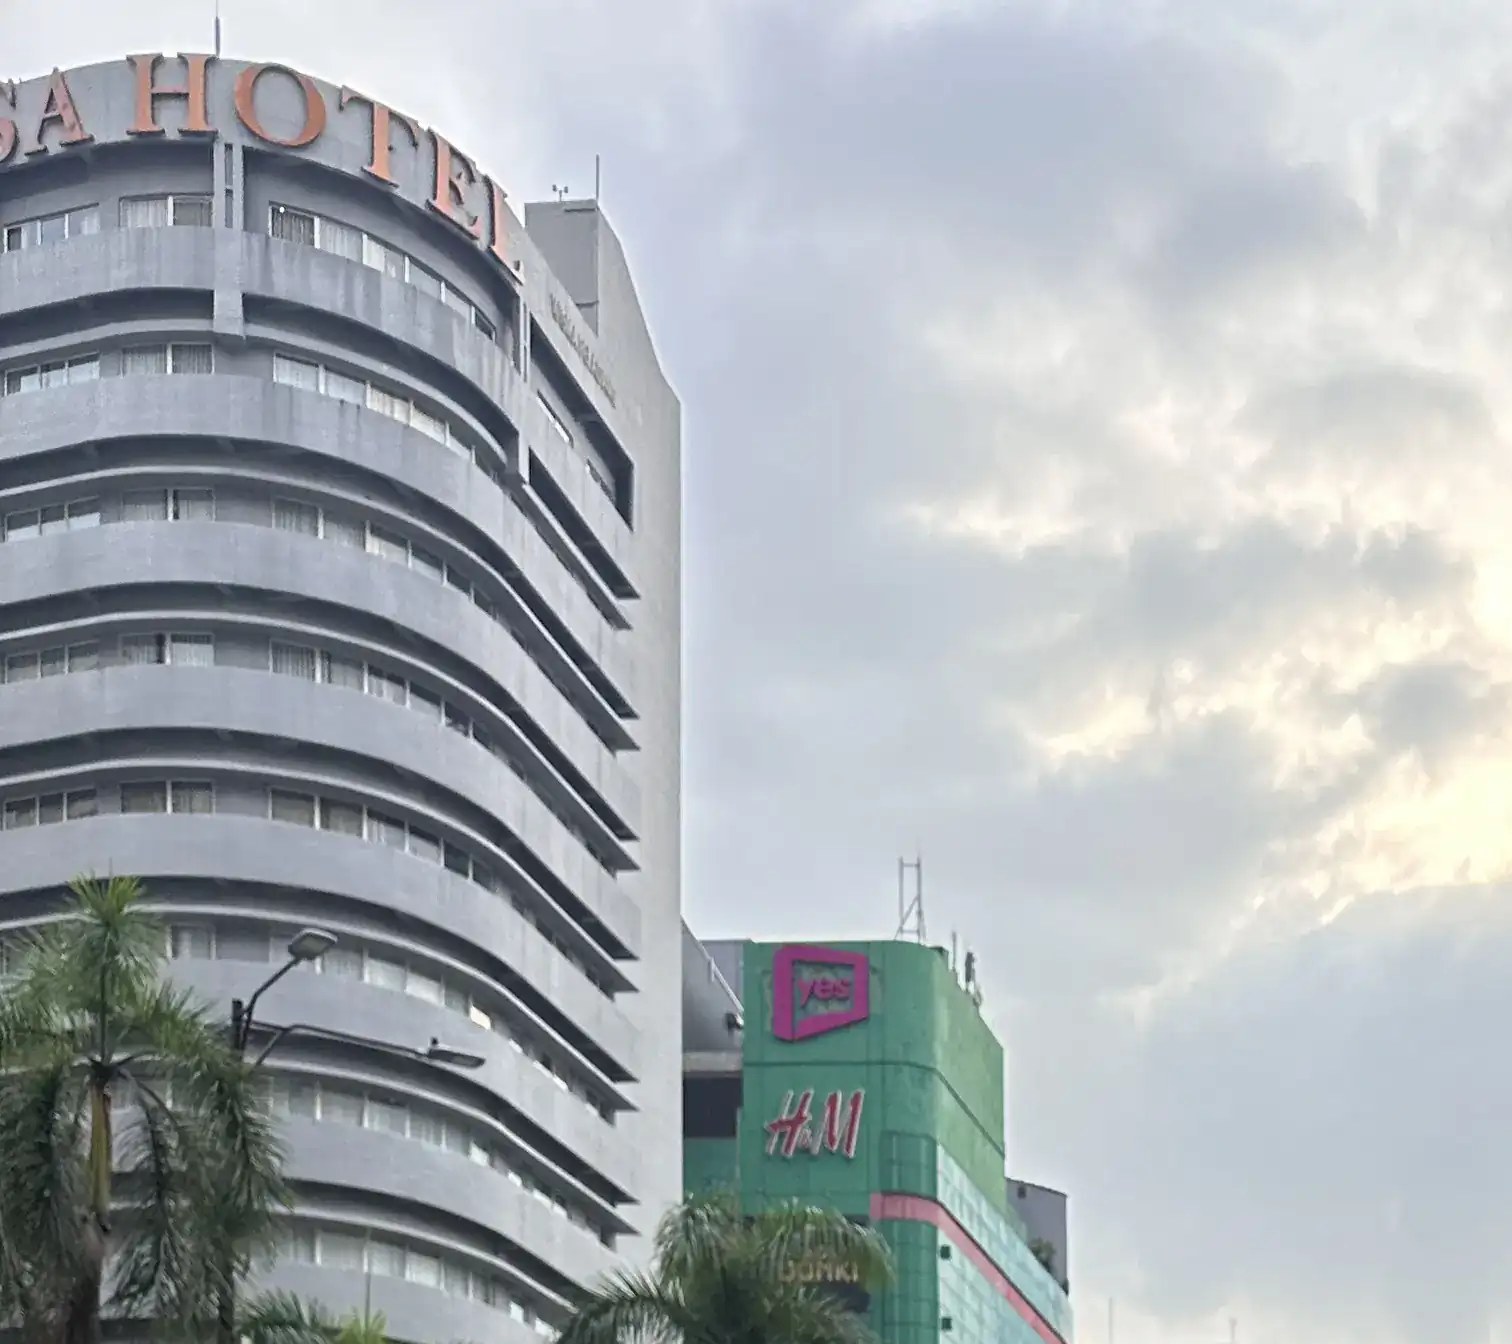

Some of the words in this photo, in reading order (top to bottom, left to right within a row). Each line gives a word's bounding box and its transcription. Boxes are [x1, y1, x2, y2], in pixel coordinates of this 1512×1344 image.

[125, 52, 526, 286] HOTEL
[797, 977, 851, 1009] yes
[764, 1088, 866, 1158] H&M
